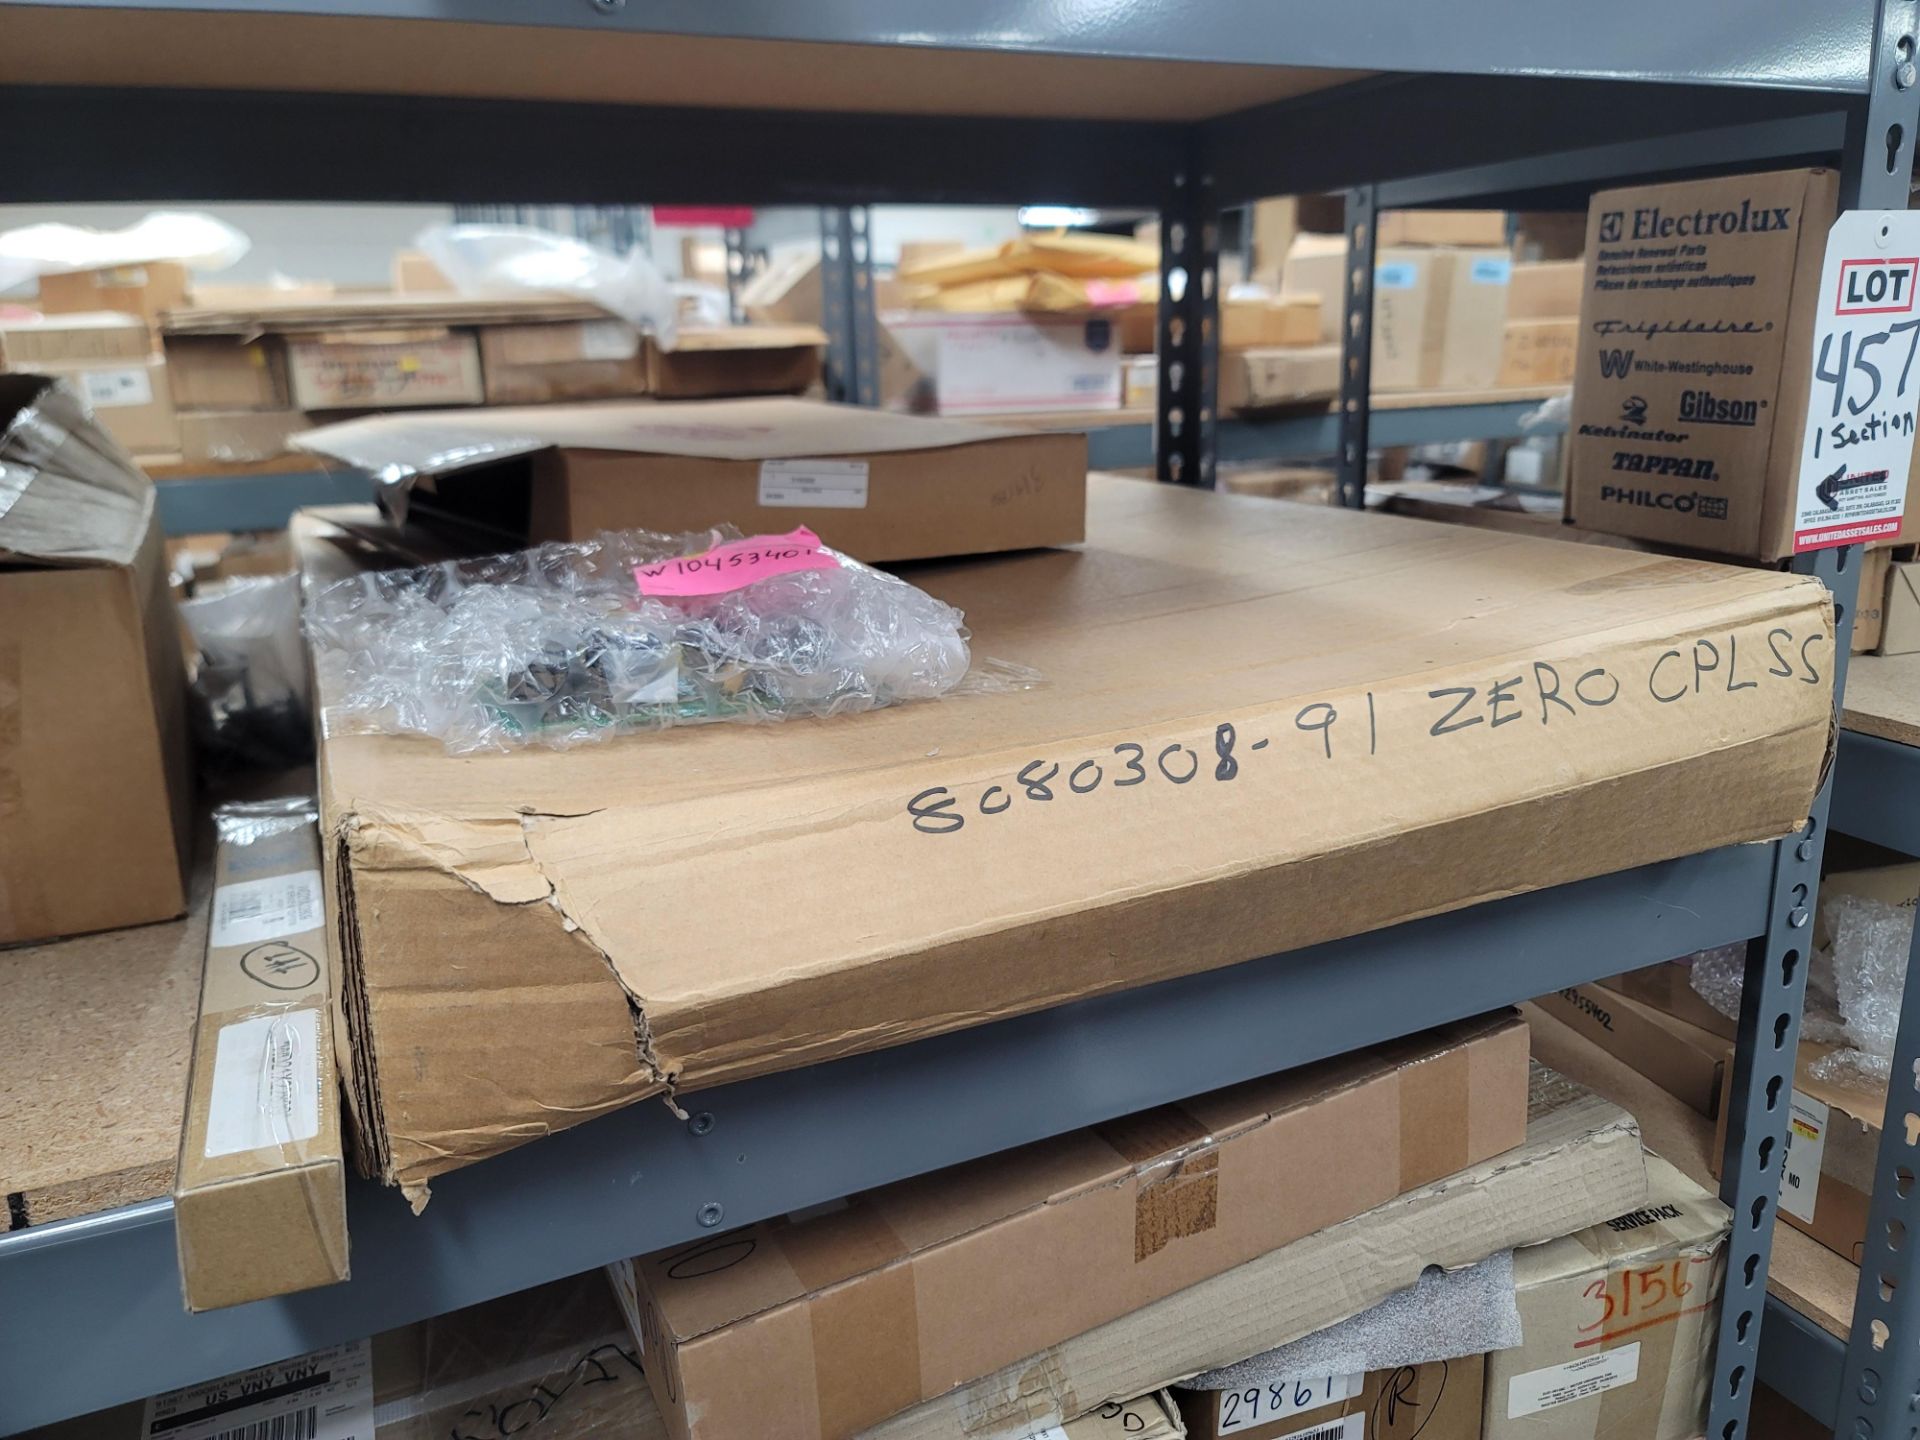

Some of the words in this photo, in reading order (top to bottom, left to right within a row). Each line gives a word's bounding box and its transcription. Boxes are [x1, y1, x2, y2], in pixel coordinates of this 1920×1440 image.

[1631, 199, 1791, 240] Electrolux
[1679, 244, 1706, 256] Parts
[1847, 269, 1910, 303] LOT
[1593, 319, 1764, 341] Frigidaire
[1634, 359, 1754, 377] White-Westinghouse
[1816, 318, 1920, 418] 457
[1679, 390, 1757, 424] Gibson
[1578, 424, 1690, 444] Kelvinator
[1831, 411, 1914, 449] Section
[1612, 452, 1715, 481] TAPPAN
[1601, 485, 1696, 513] PHILCO
[1428, 662, 1620, 737] ZERO
[1605, 1209, 1657, 1233] SERVICE
[1652, 1203, 1684, 1222] PACK
[1222, 1376, 1332, 1428] 29861
[1388, 1366, 1421, 1426] R
